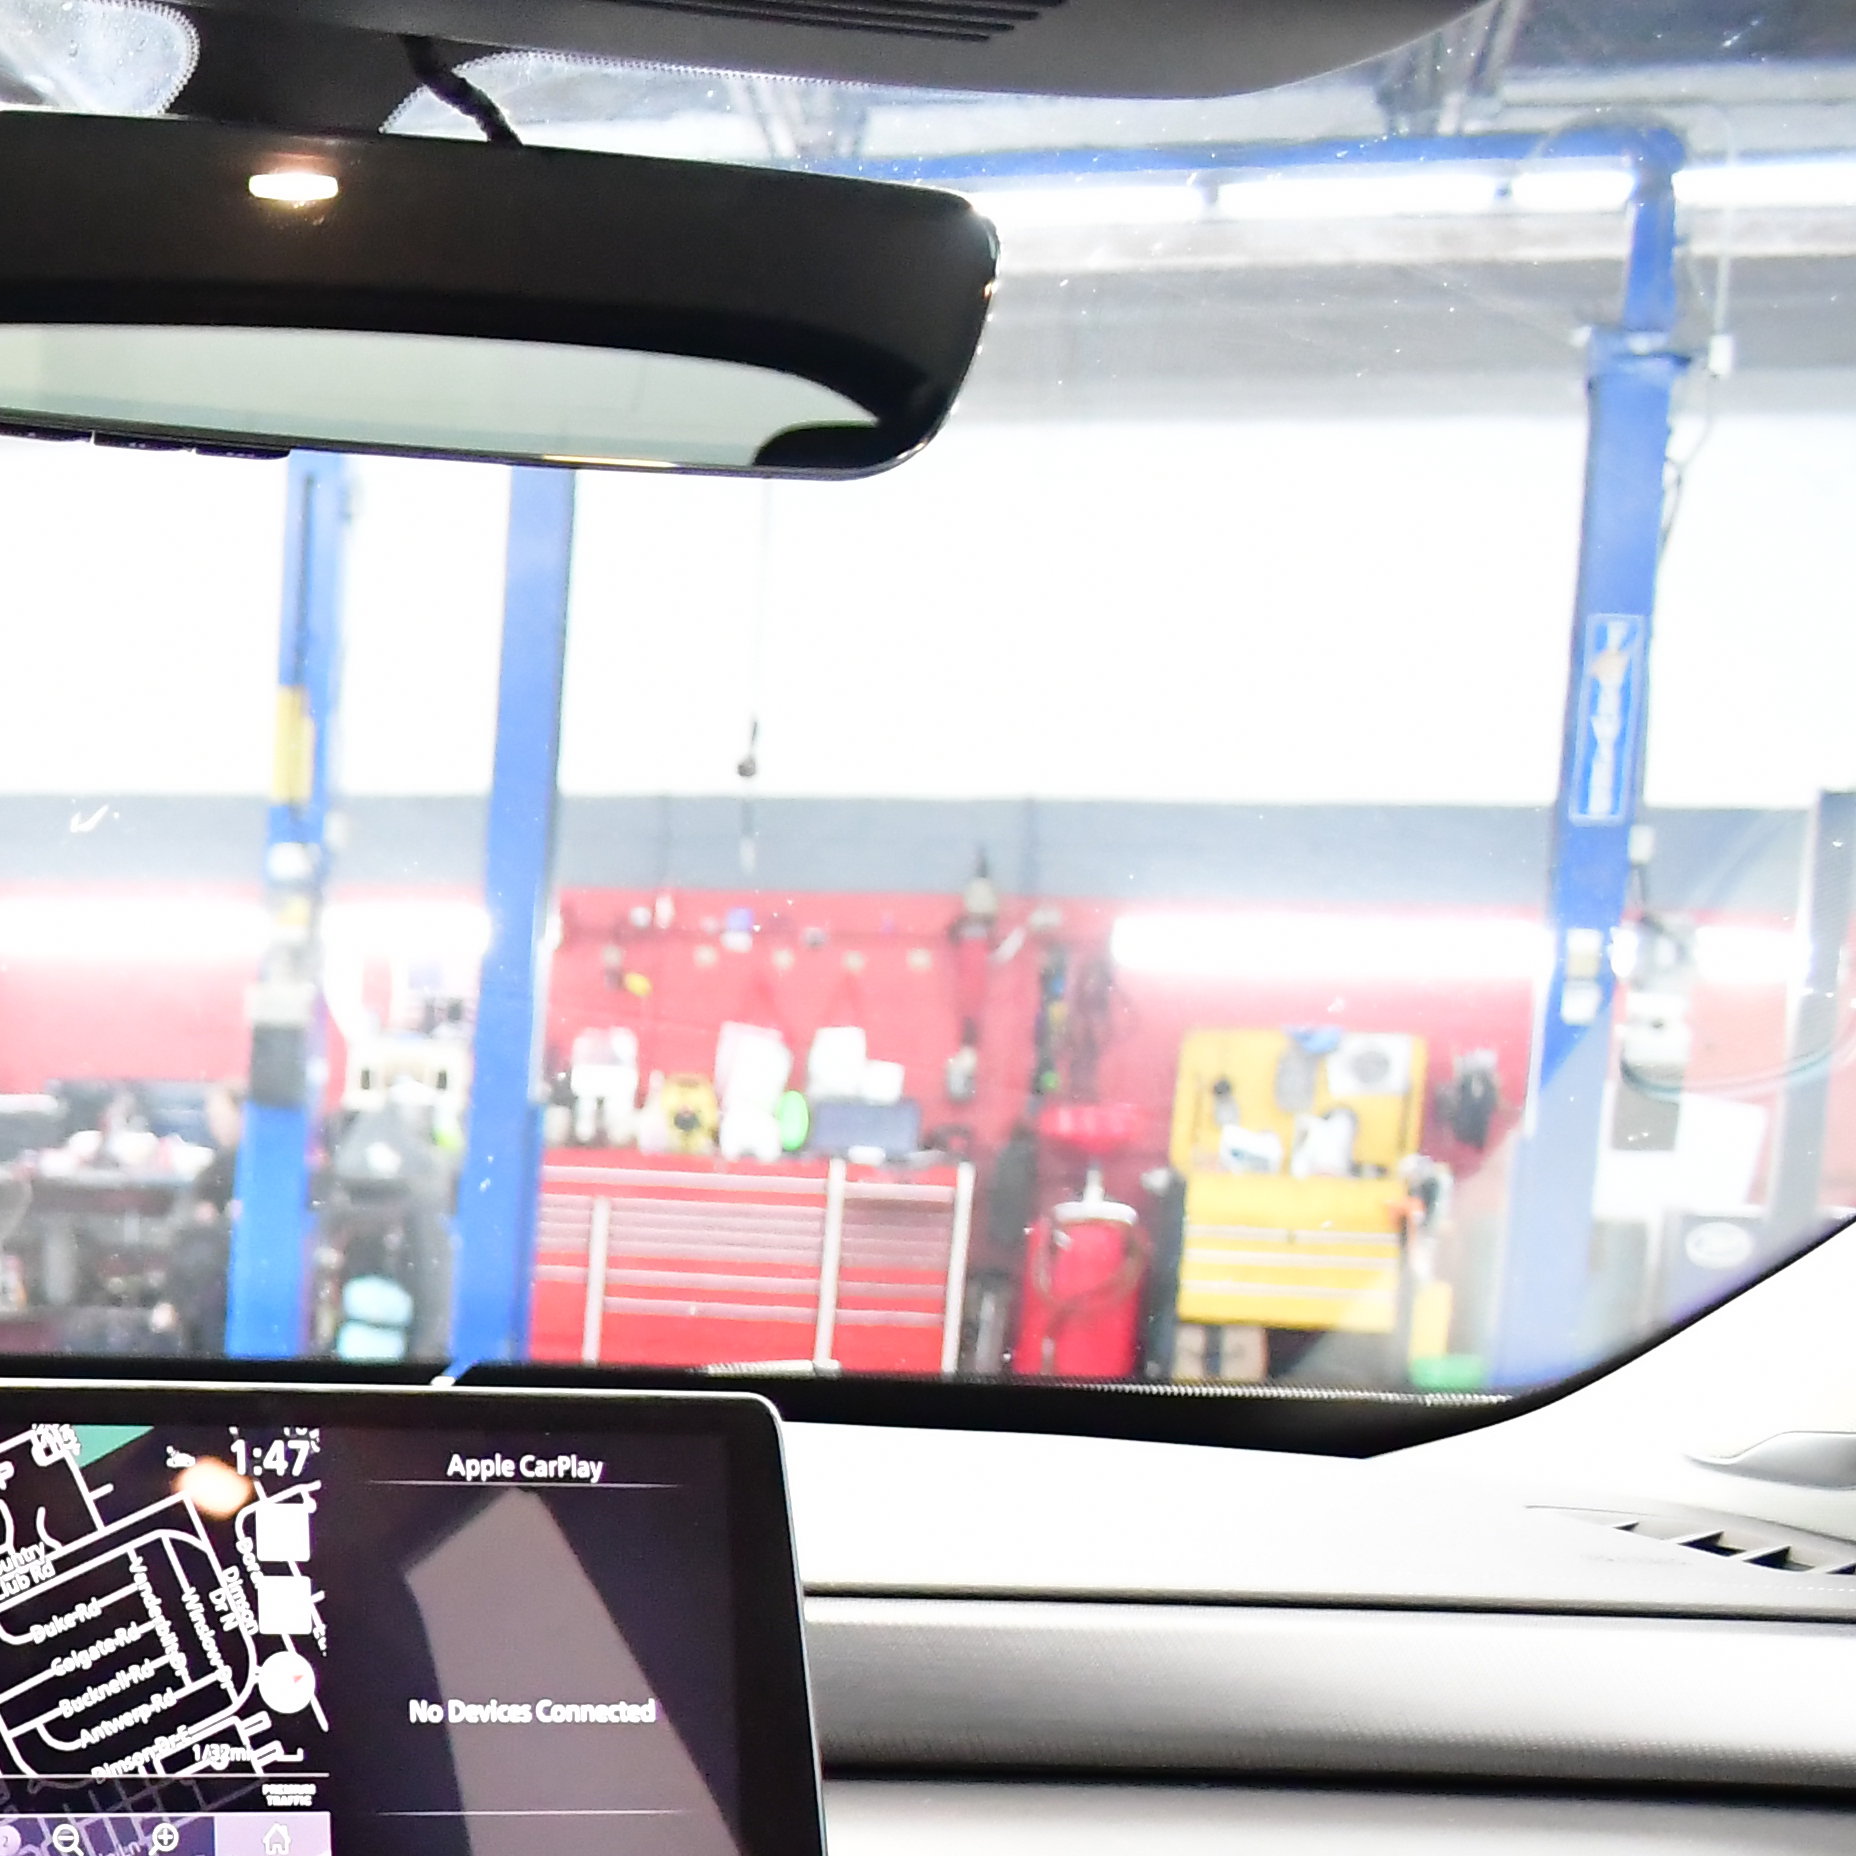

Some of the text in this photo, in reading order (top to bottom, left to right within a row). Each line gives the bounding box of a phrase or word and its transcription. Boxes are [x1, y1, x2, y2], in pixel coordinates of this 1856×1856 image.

[231, 1439, 310, 1477] 1:47
[447, 1453, 603, 1483] Apple CarPlay
[30, 1557, 55, 1583] Rd
[209, 1588, 230, 1614] Dr
[30, 1597, 102, 1645] Duke Rd
[115, 1617, 142, 1645] Rd
[129, 1658, 155, 1683] Rd
[152, 1687, 178, 1711] Rd
[409, 1699, 656, 1723] No Devices Connected
